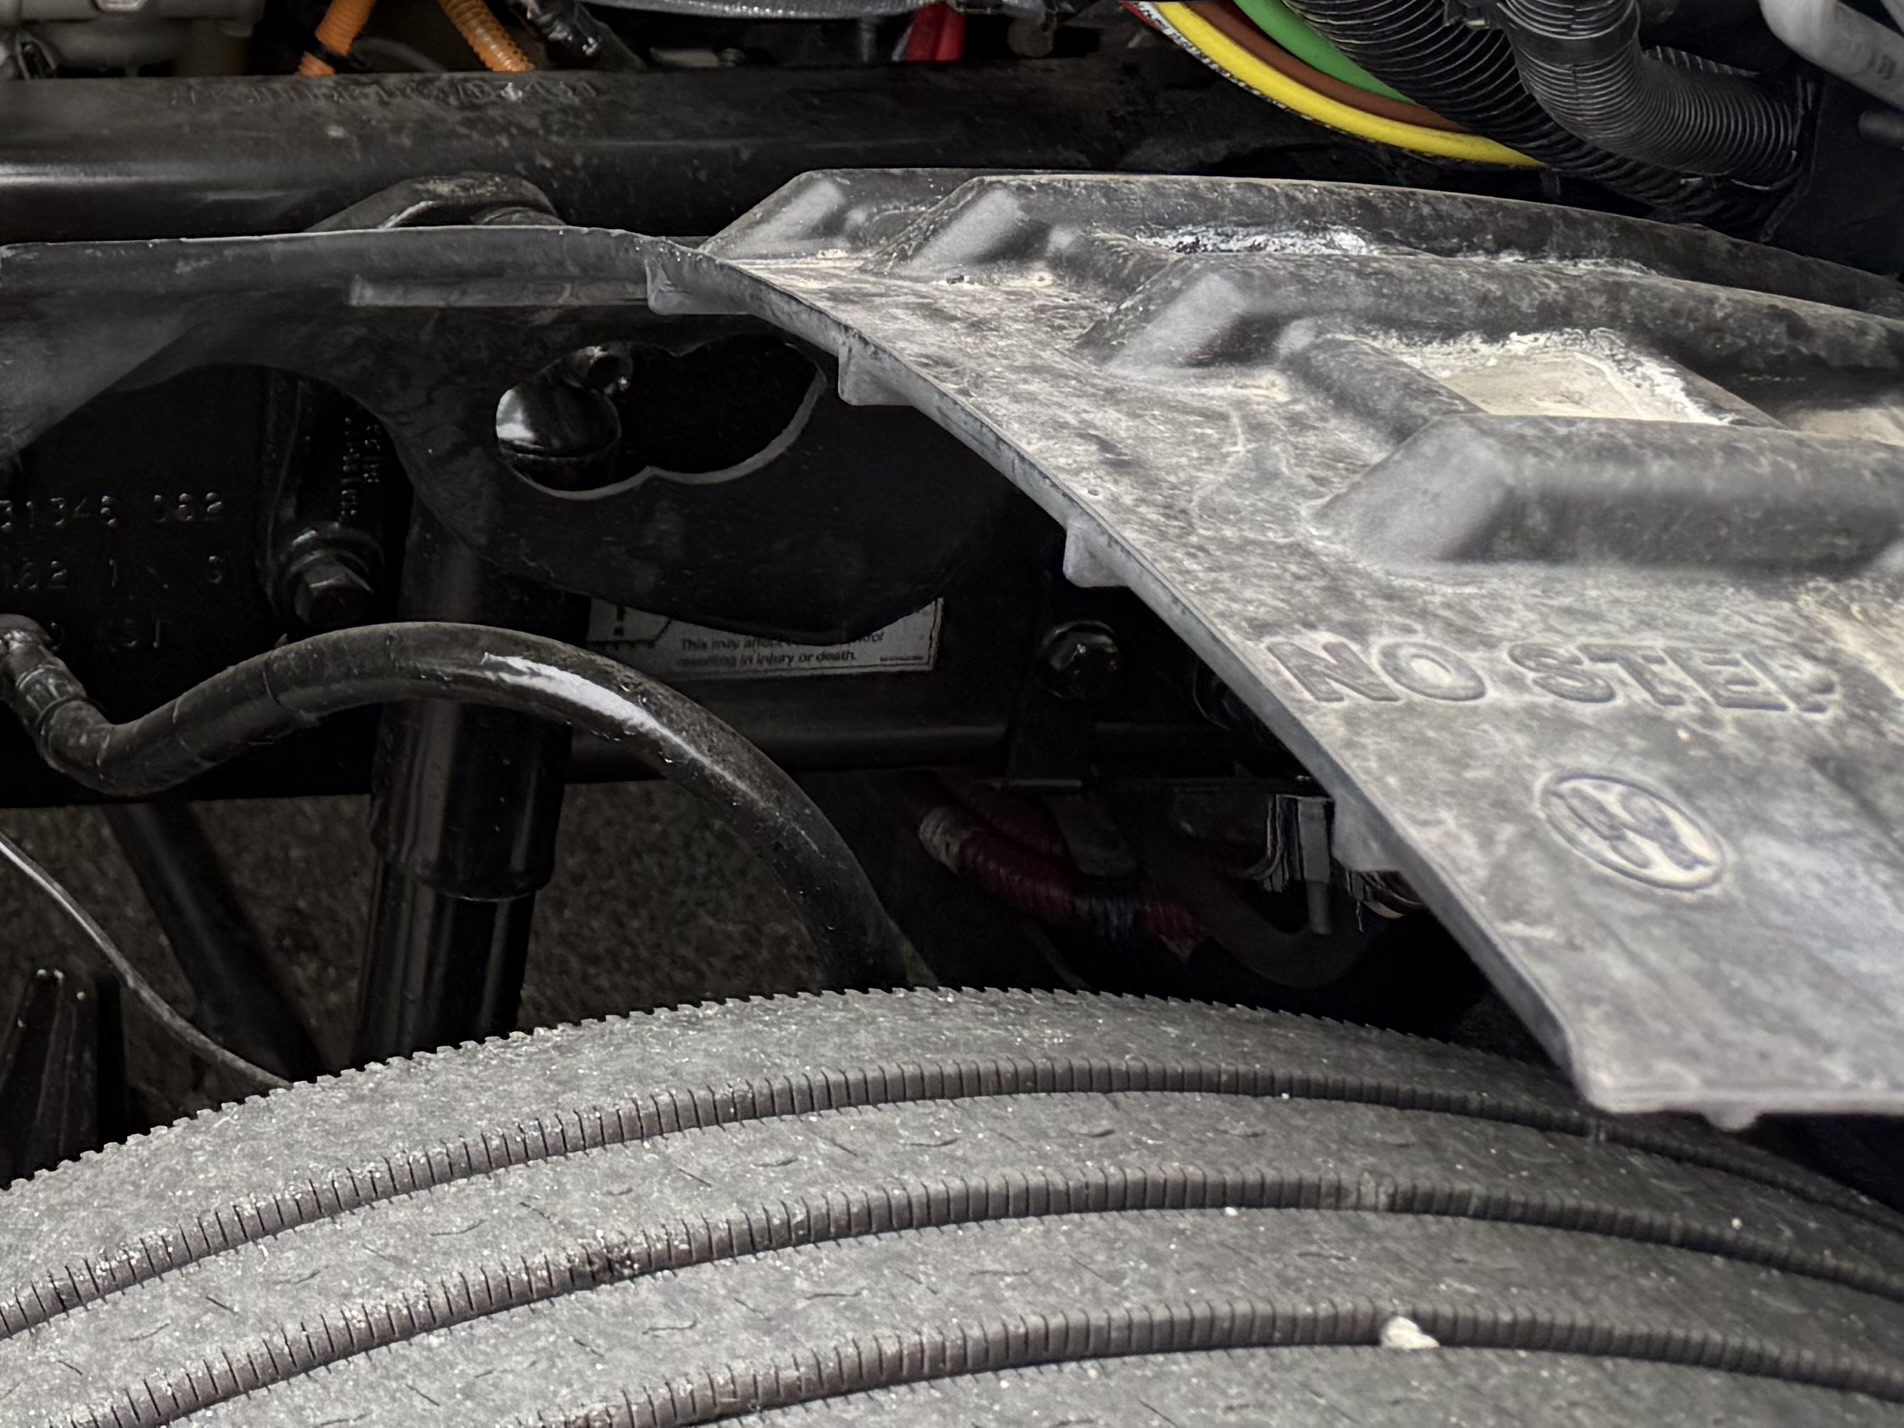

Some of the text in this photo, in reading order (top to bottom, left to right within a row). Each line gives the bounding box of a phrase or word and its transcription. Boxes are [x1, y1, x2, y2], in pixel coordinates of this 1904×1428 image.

[680, 638, 707, 652] This
[740, 652, 753, 664] in
[756, 651, 794, 666] injury
[797, 652, 813, 662] or
[815, 649, 857, 661] death.
[1264, 640, 1839, 714] NO STEP
